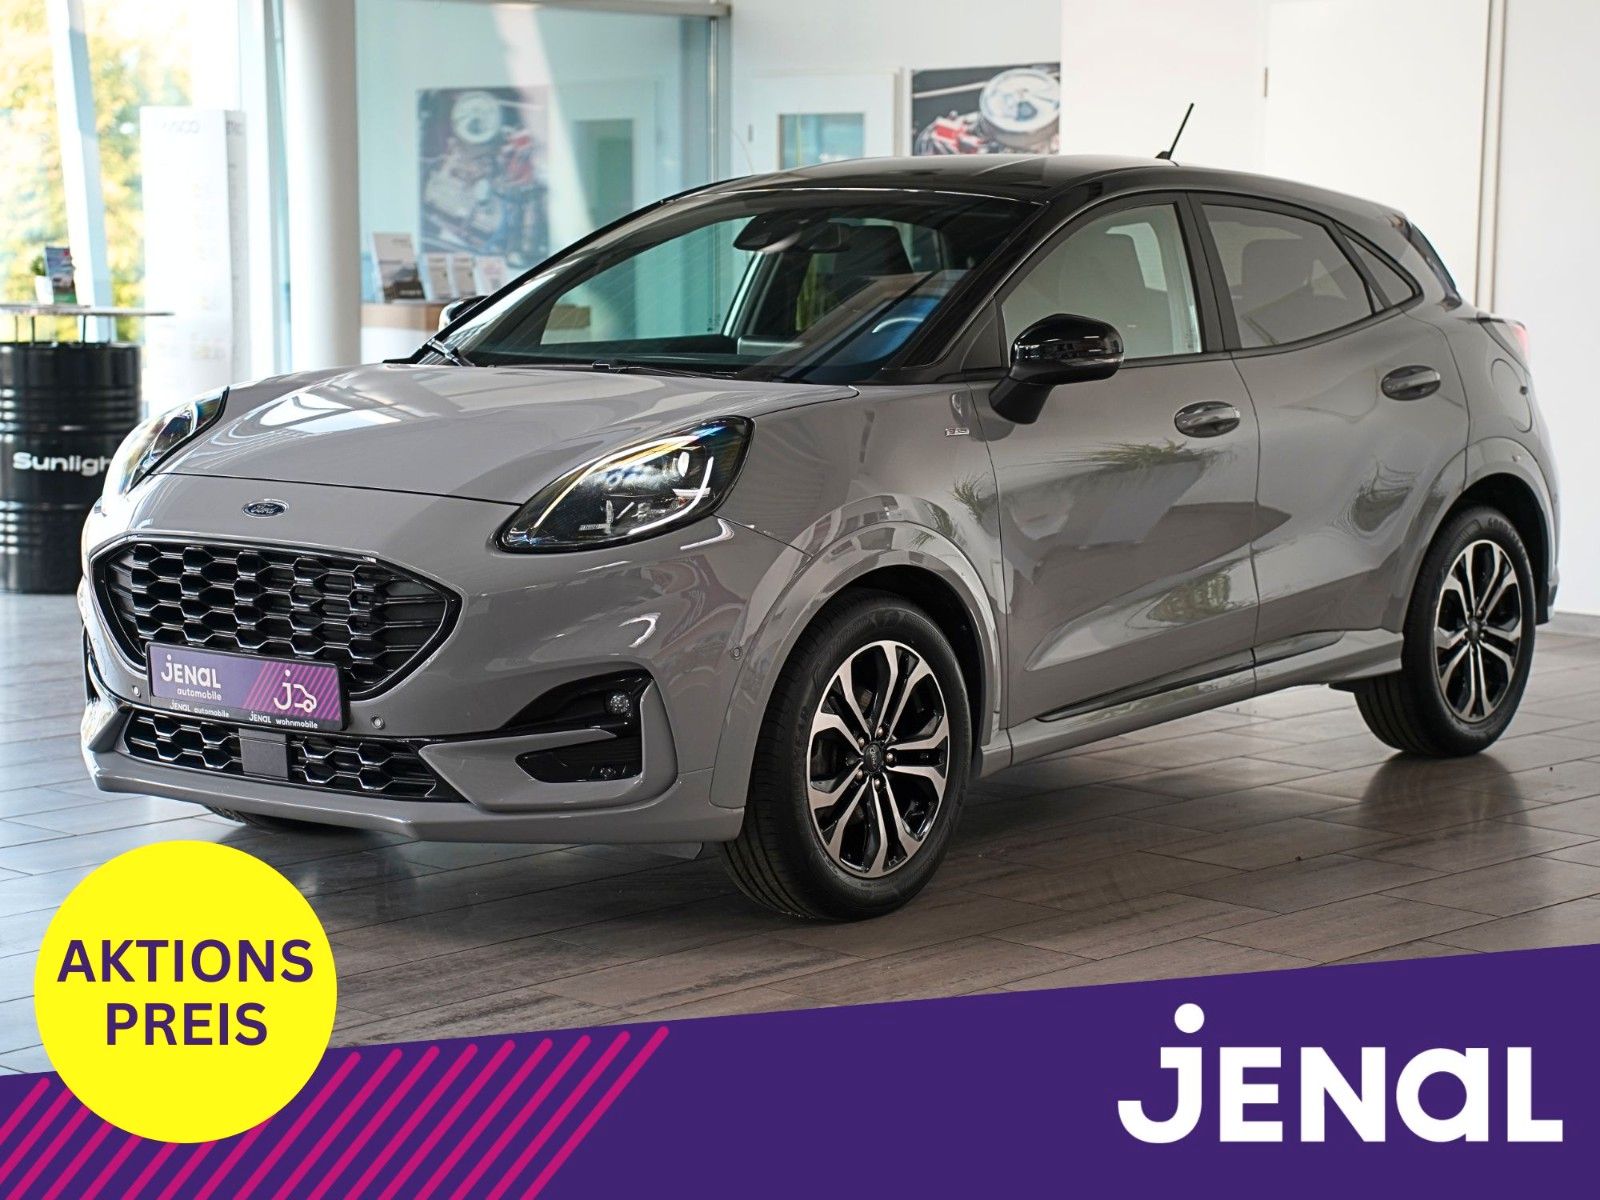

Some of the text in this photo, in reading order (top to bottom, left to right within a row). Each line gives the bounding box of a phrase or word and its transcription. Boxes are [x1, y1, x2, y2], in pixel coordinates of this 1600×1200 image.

[177, 687, 222, 701] automobile
[194, 706, 230, 719] automobile
[275, 717, 319, 730] wohnmobile
